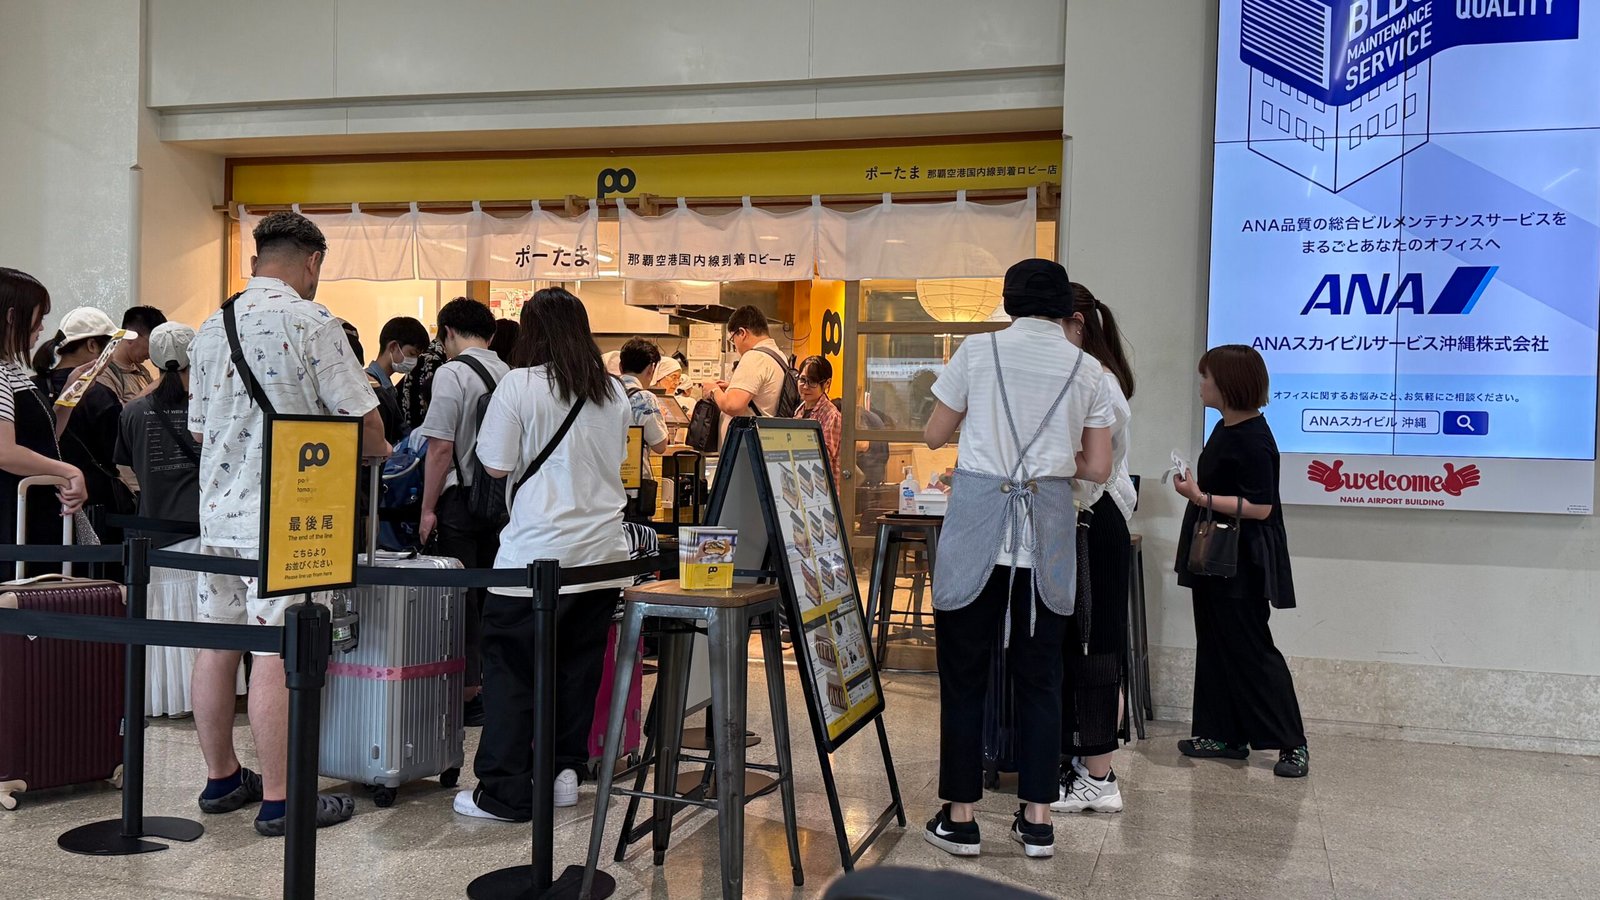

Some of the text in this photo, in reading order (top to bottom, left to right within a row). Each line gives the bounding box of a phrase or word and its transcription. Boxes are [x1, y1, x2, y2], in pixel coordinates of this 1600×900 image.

[1348, 0, 1422, 42] BLD
[1347, 1, 1432, 63] MAINTENANCE
[1345, 21, 1433, 91] SERVICE
[865, 164, 1058, 181] ポーたま 那覇空港国内線到着ロビー店
[1241, 211, 1567, 233] ANA品質の総合ビルメンテナンスサービスを
[1301, 237, 1501, 254] まるごとあなたのオフィスへ
[515, 245, 590, 268] ポーたま
[627, 252, 796, 267] 那覇空港国内線到着ロビー店
[1300, 273, 1424, 315] ANA
[1252, 335, 1549, 352] ANAスカイビルサービス沖縄株式会社
[1273, 391, 1520, 403] オフィスに関するお悩みごと、お気軽にご相談ください。
[1309, 416, 1427, 429] ANAスカイビル 沖縄
[1342, 470, 1445, 493] welcome
[1340, 496, 1445, 507] NAHA AIRPORT BUILDING
[289, 514, 333, 531] 最後尾
[293, 547, 326, 558] こちらより
[285, 559, 333, 571] お並びください
